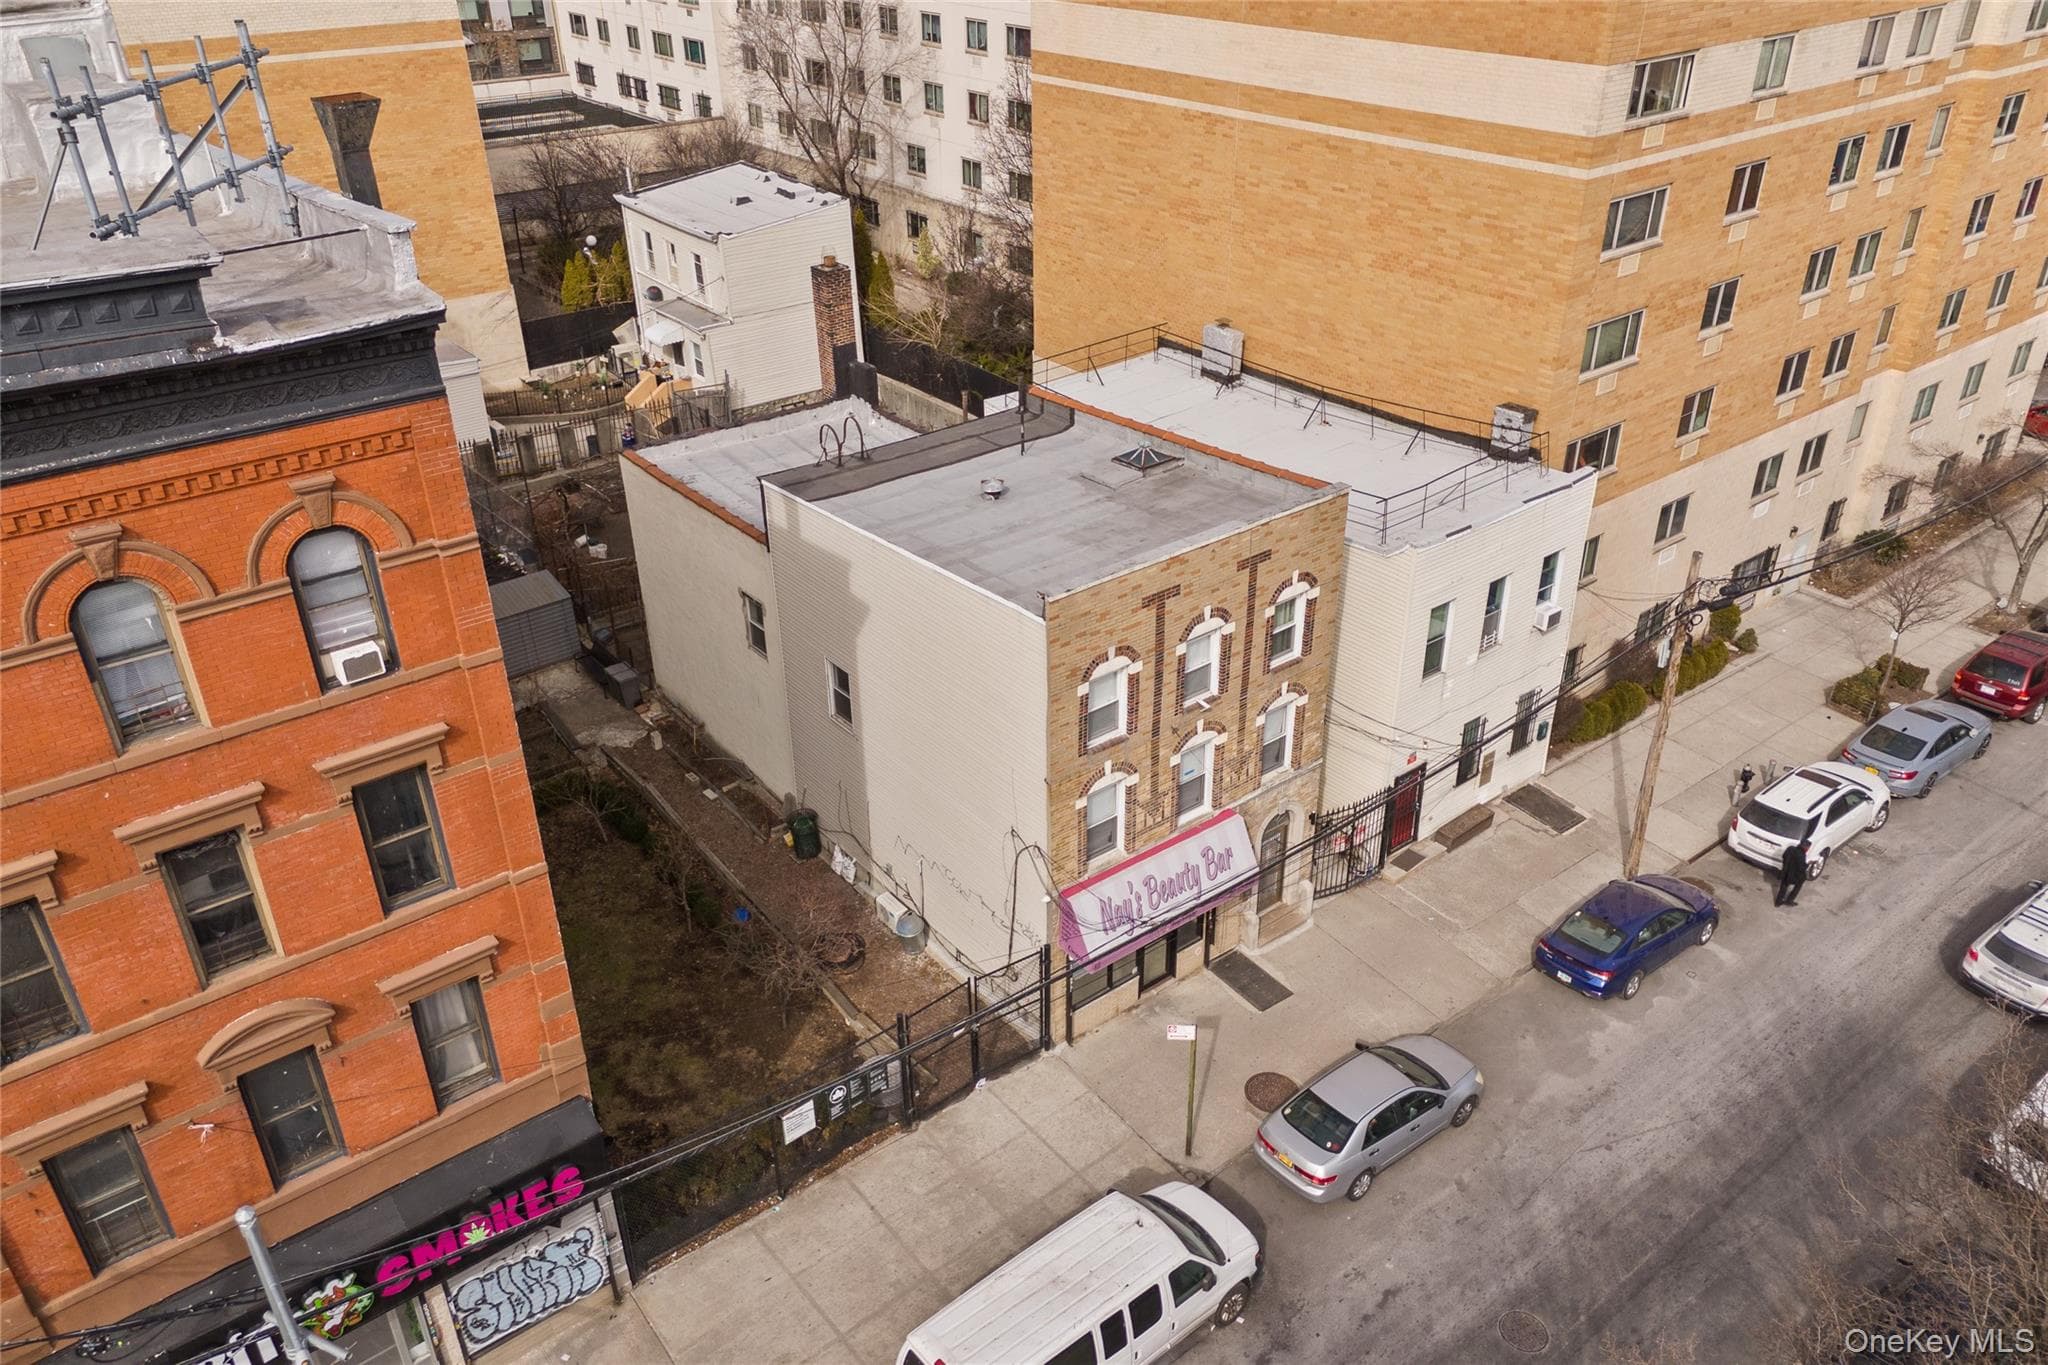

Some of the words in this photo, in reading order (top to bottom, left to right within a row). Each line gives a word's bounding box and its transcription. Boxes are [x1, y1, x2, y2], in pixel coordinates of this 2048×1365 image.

[1100, 881, 1144, 936] Nay's
[1143, 862, 1201, 911] Beauty
[1200, 845, 1234, 882] Bar
[376, 1164, 585, 1297] SMOKES
